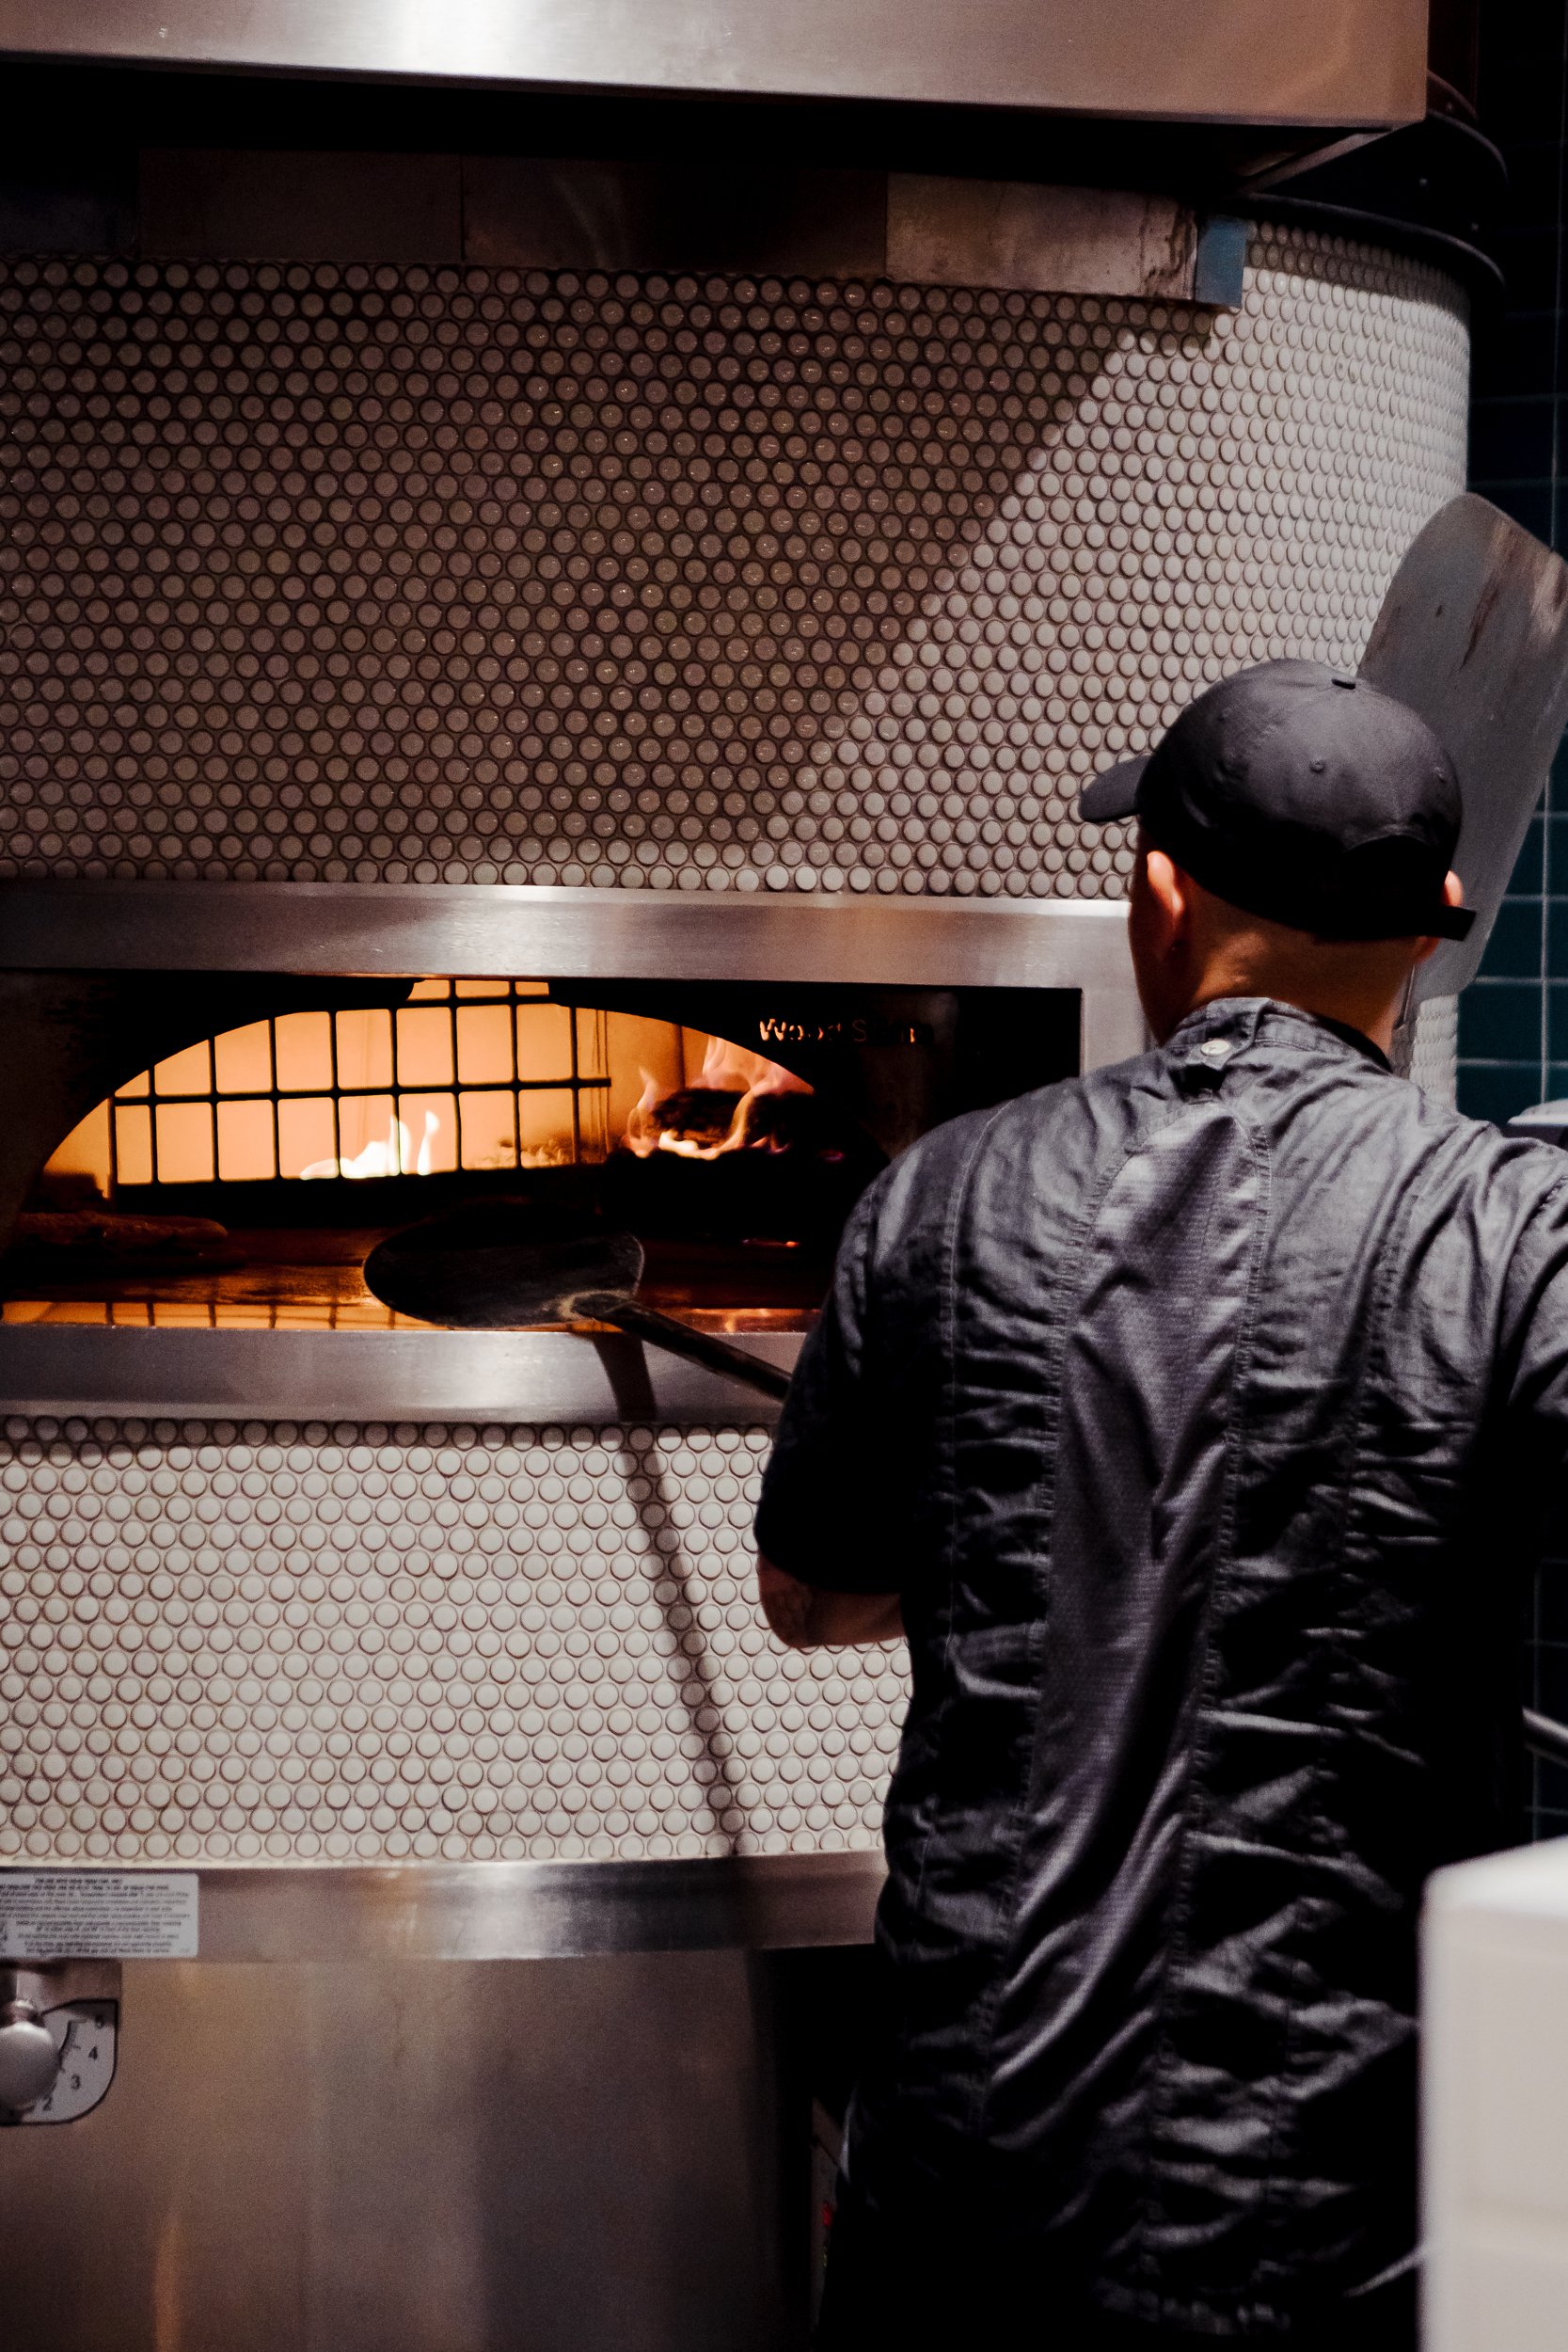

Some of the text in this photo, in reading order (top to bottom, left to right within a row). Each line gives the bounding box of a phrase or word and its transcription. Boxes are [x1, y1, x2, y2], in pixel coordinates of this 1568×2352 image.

[88, 2045, 98, 2060] 4
[71, 2074, 80, 2090] 3
[42, 2096, 52, 2110] 2
